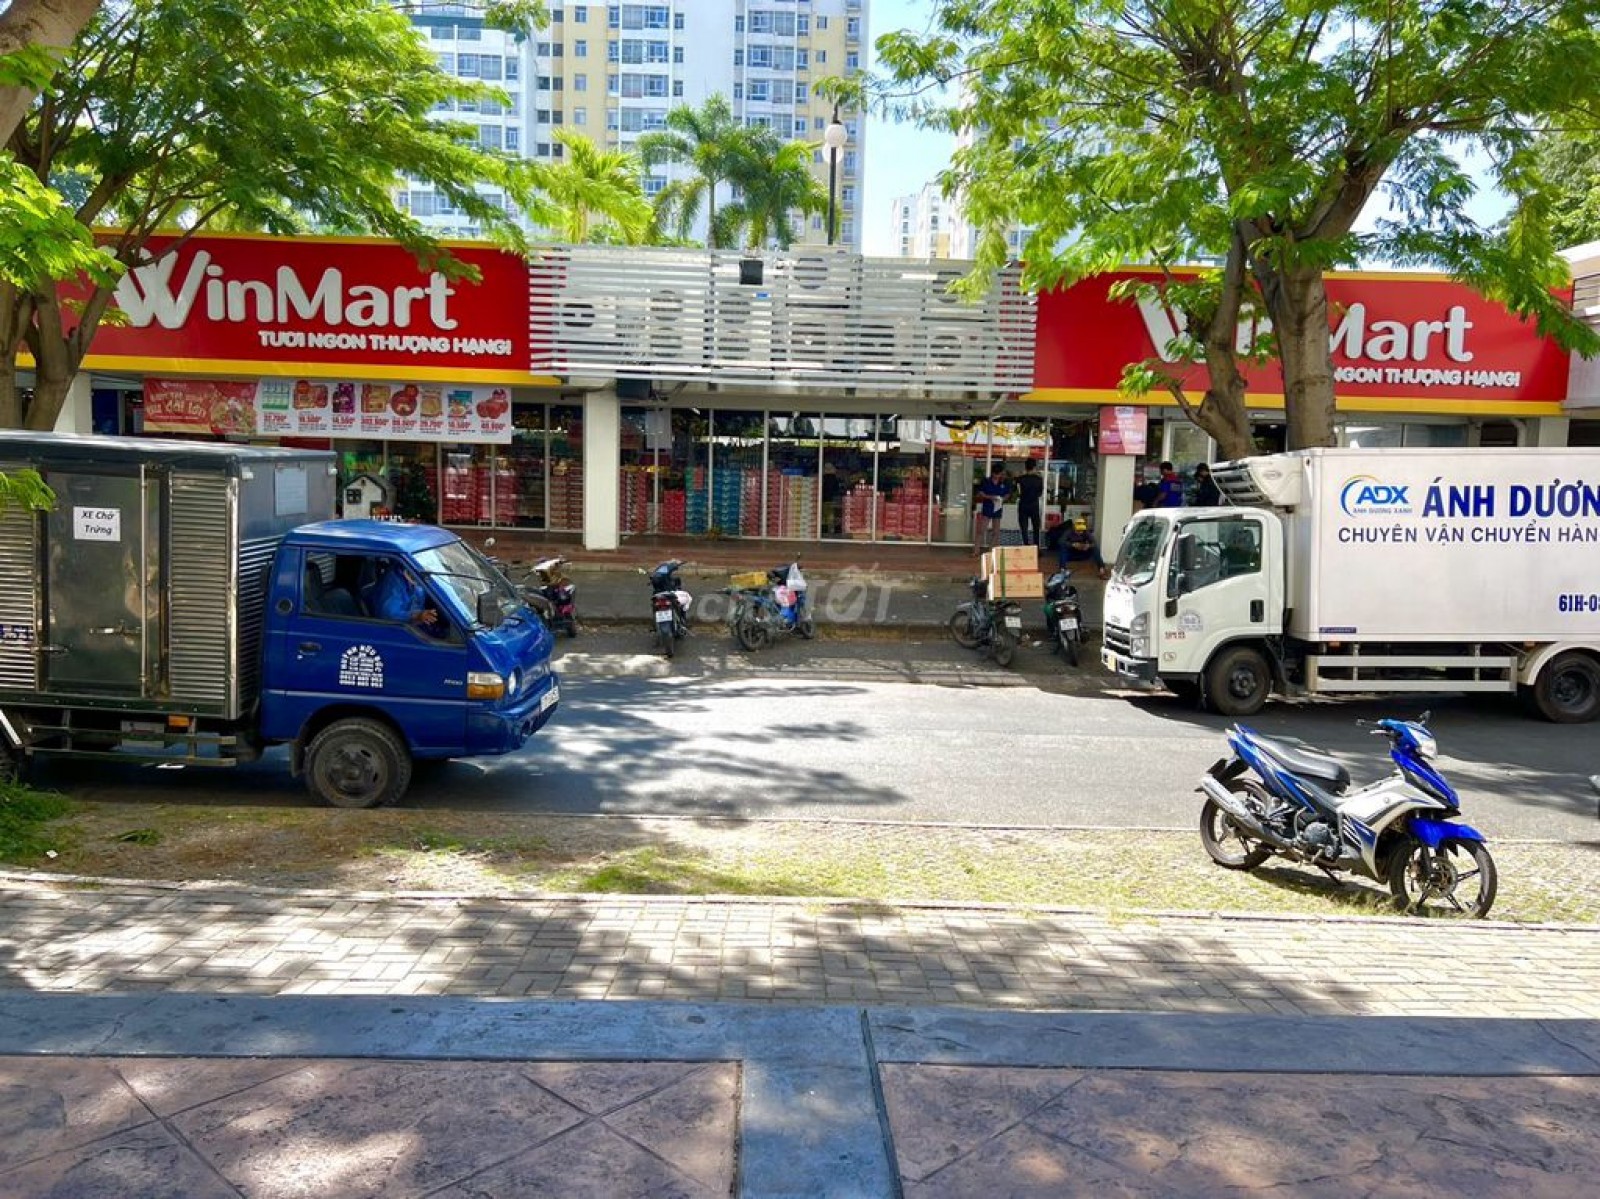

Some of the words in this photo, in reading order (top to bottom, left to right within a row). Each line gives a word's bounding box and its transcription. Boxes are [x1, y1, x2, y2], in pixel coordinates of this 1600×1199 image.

[98, 244, 458, 329] WinMart
[308, 332, 367, 350] NGON
[1356, 485, 1409, 504] ADX
[1422, 476, 1495, 518] ÁNH
[1509, 478, 1600, 518] DƯƠN
[1338, 523, 1417, 543] CHUYÊN
[1425, 523, 1464, 546] VẬN
[1471, 519, 1551, 543] CHUYỂN
[1557, 523, 1598, 542] HÀN
